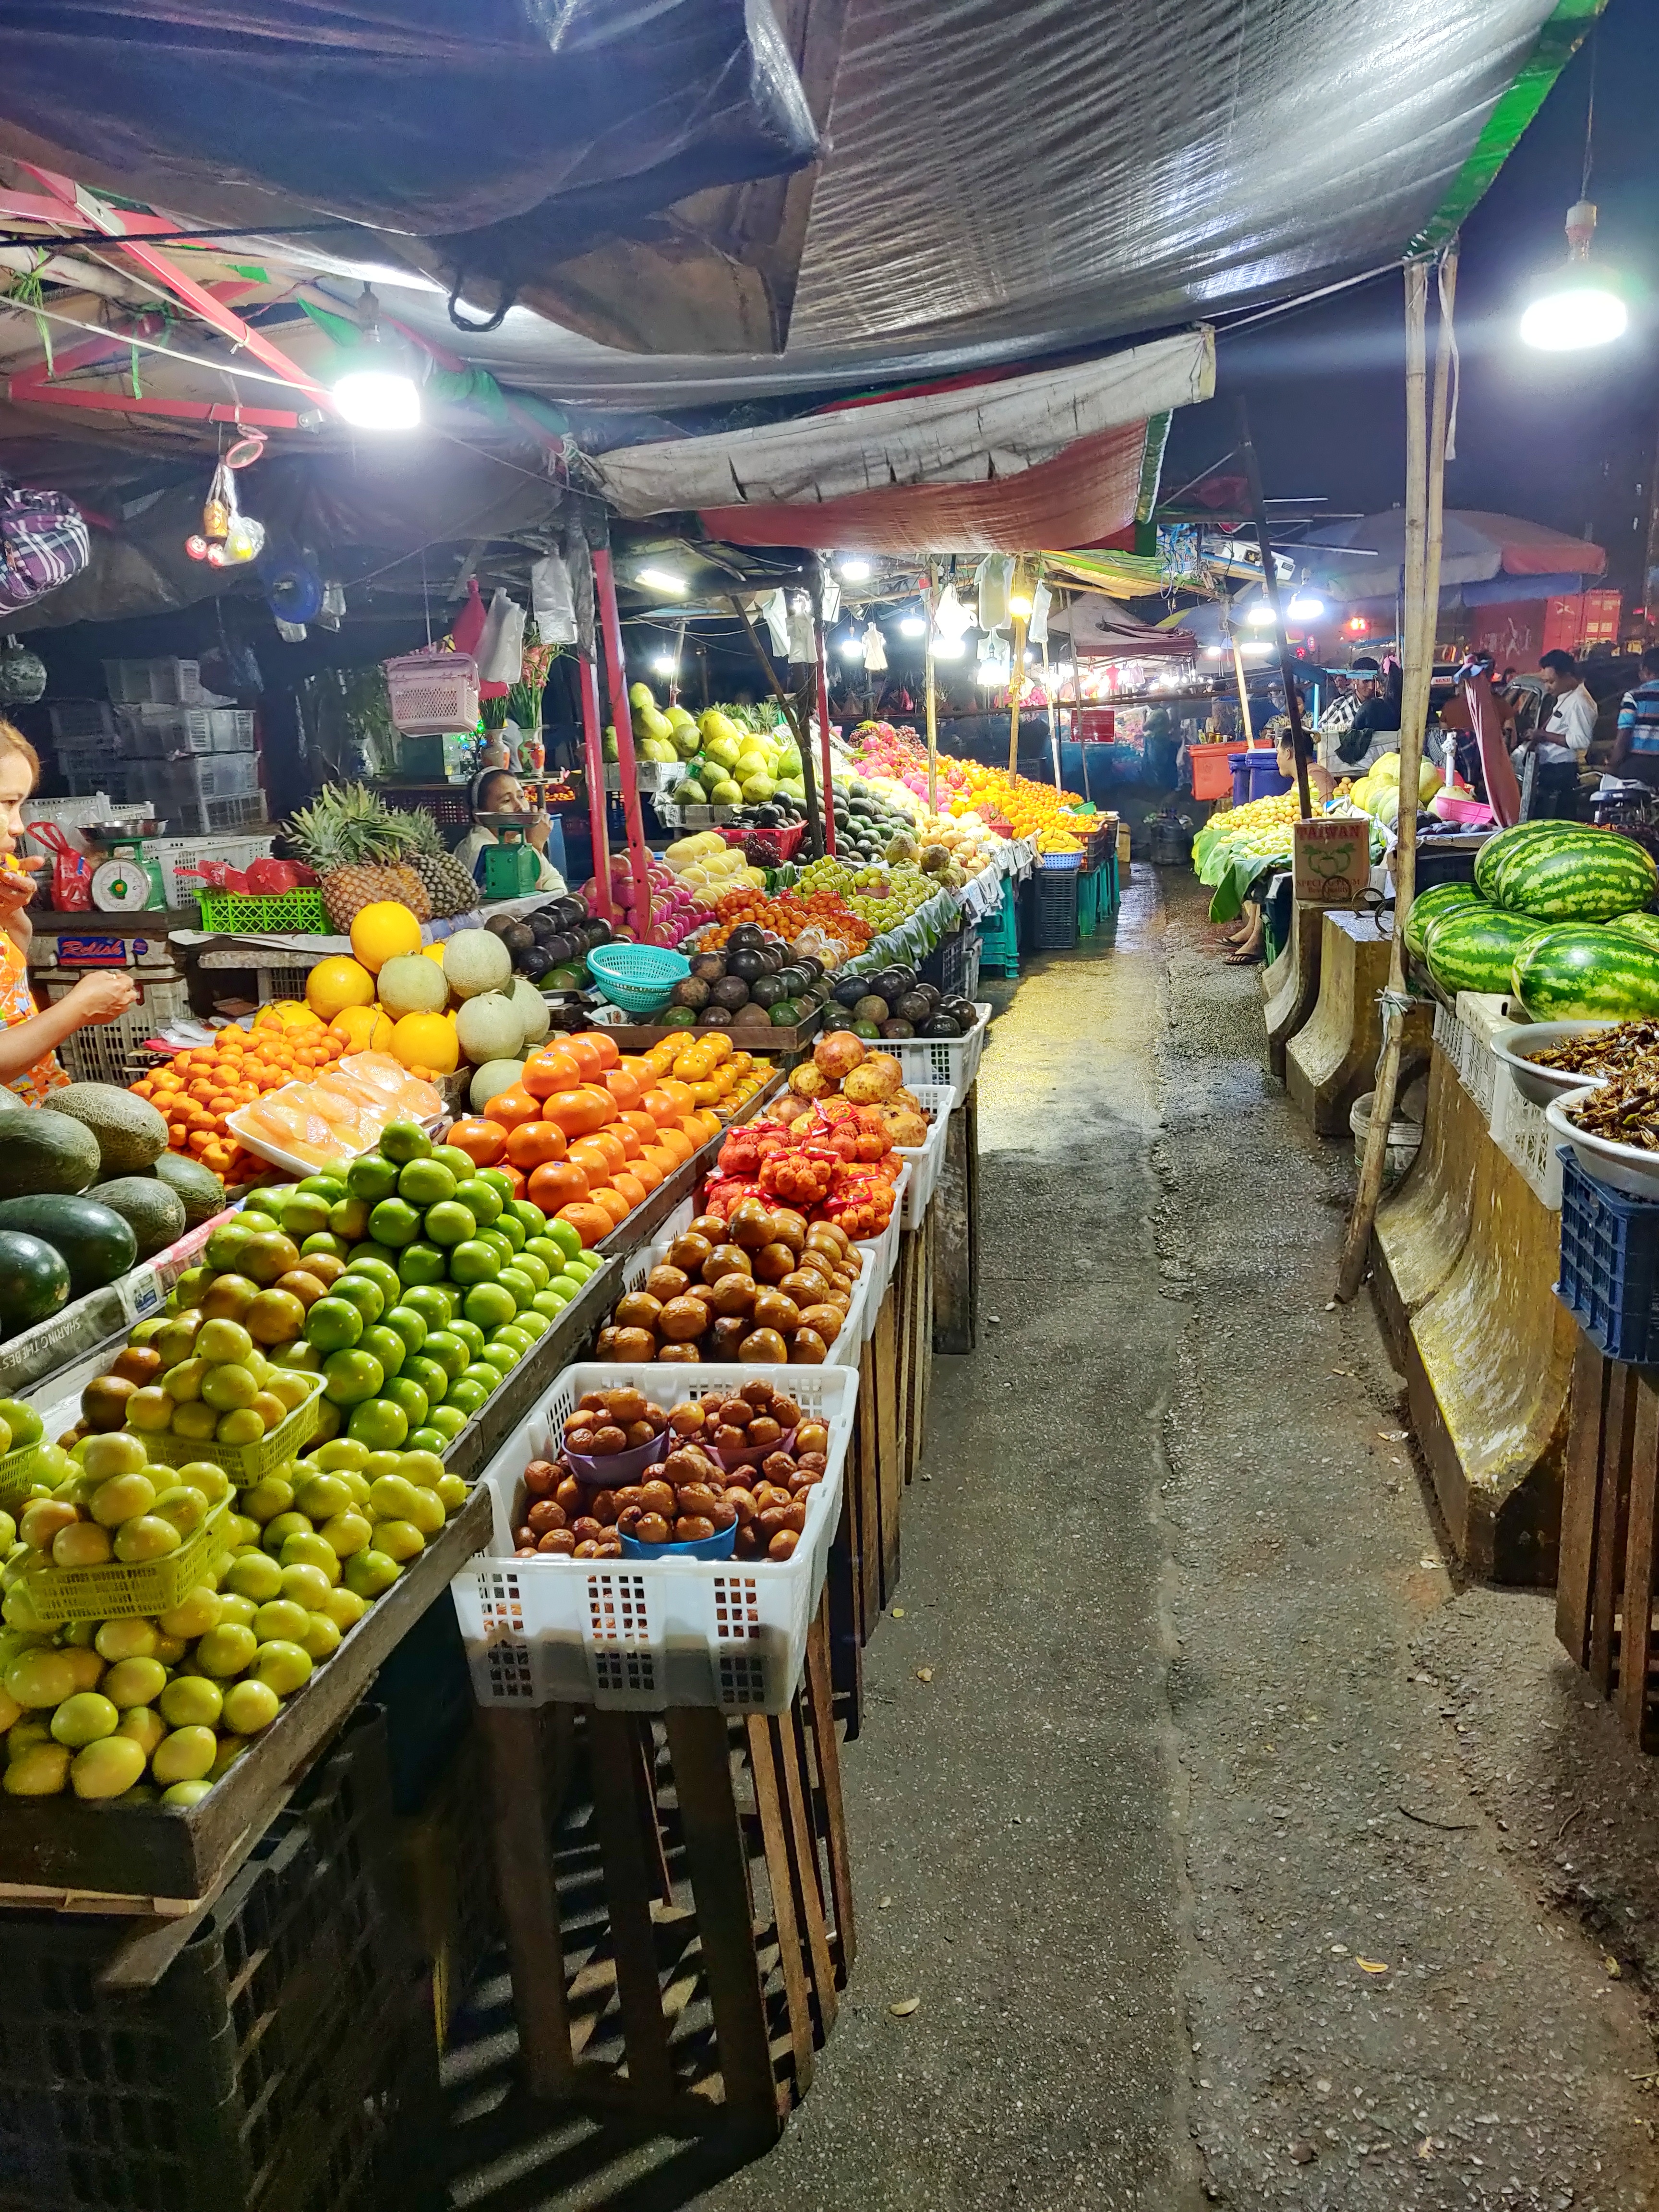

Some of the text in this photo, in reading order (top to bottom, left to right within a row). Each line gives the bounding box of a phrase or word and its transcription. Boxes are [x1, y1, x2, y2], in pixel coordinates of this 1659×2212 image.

[1297, 825, 1359, 840] TAIWAN
[0, 1317, 81, 1370] SHARING THE BES
